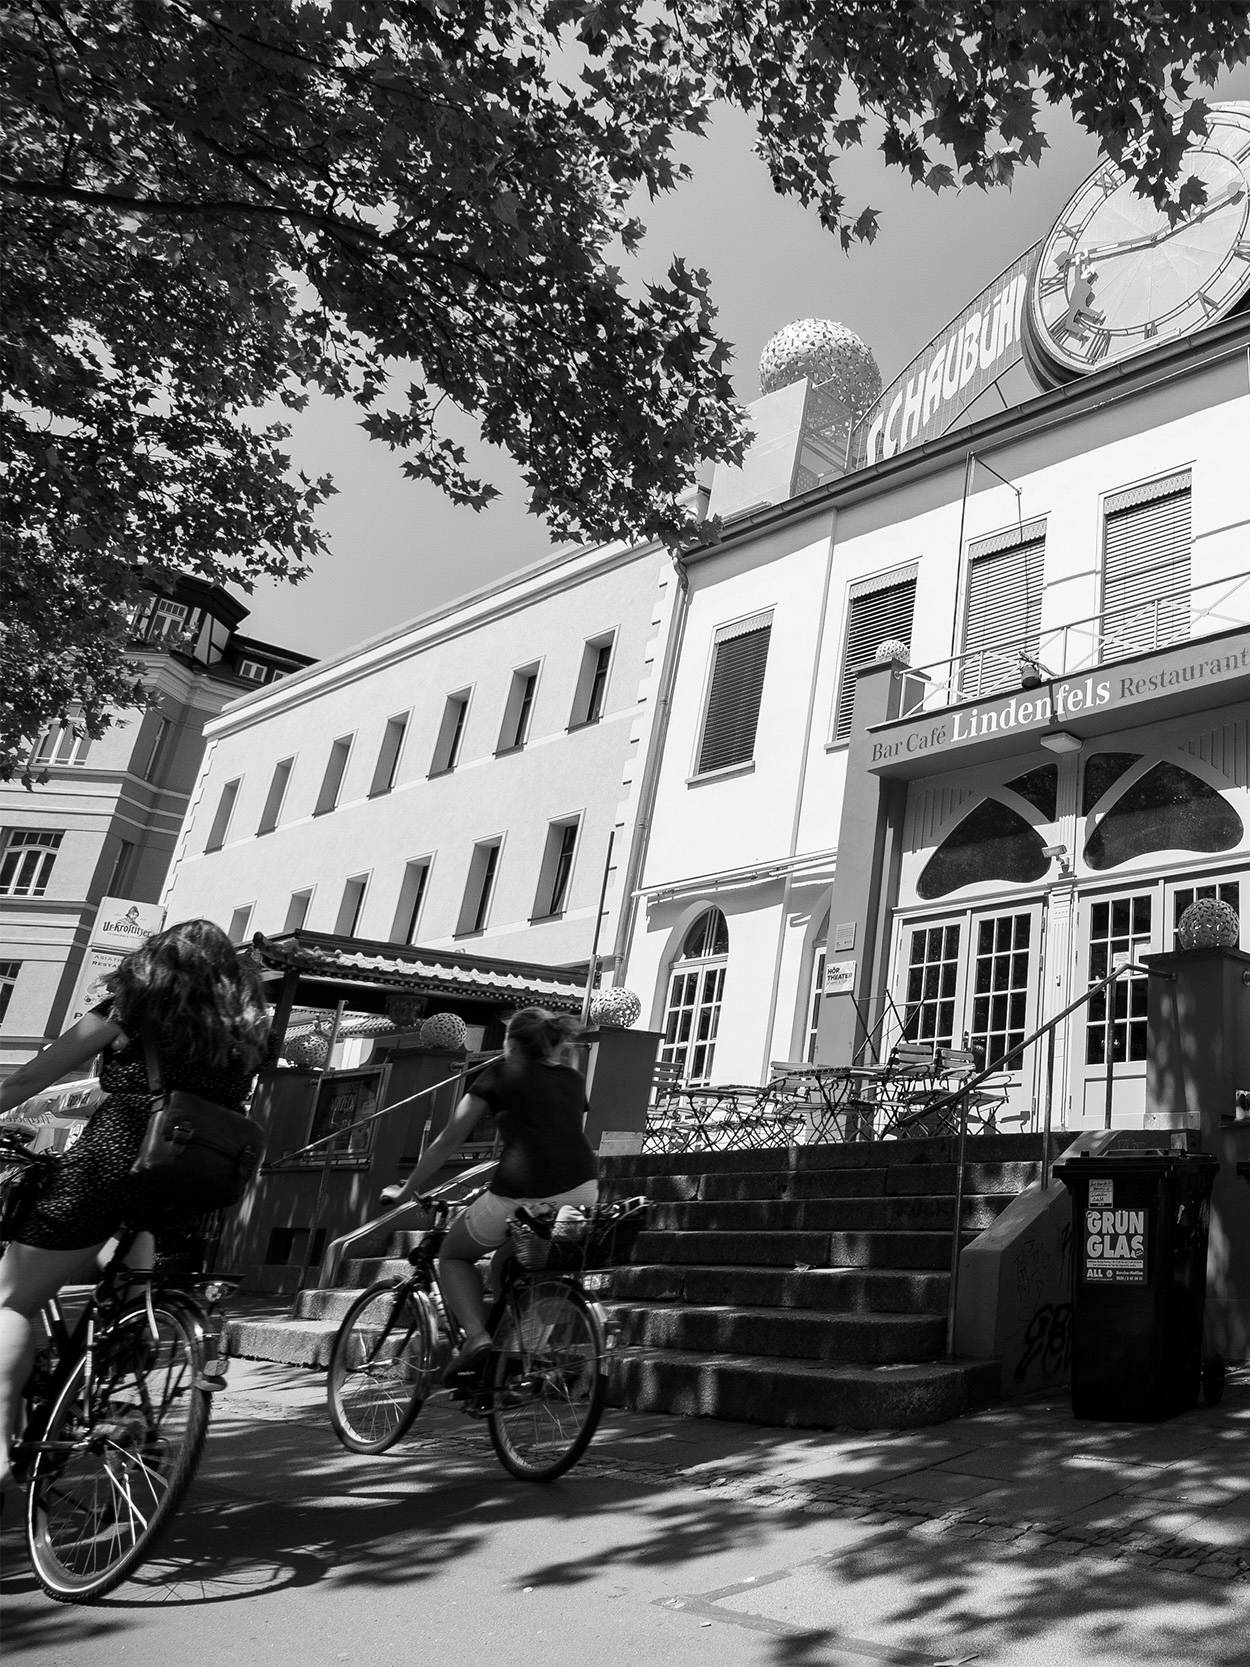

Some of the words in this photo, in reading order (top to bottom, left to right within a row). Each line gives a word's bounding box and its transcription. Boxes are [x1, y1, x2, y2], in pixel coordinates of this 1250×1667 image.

[871, 740, 902, 762] Bar
[906, 724, 947, 753] Café
[950, 677, 1111, 743] Lindenfels
[1119, 646, 1250, 700] Restaurant
[1087, 1210, 1144, 1234] GRÜN
[1087, 1235, 1144, 1258] GLAS
[1087, 1269, 1103, 1277] ALL
